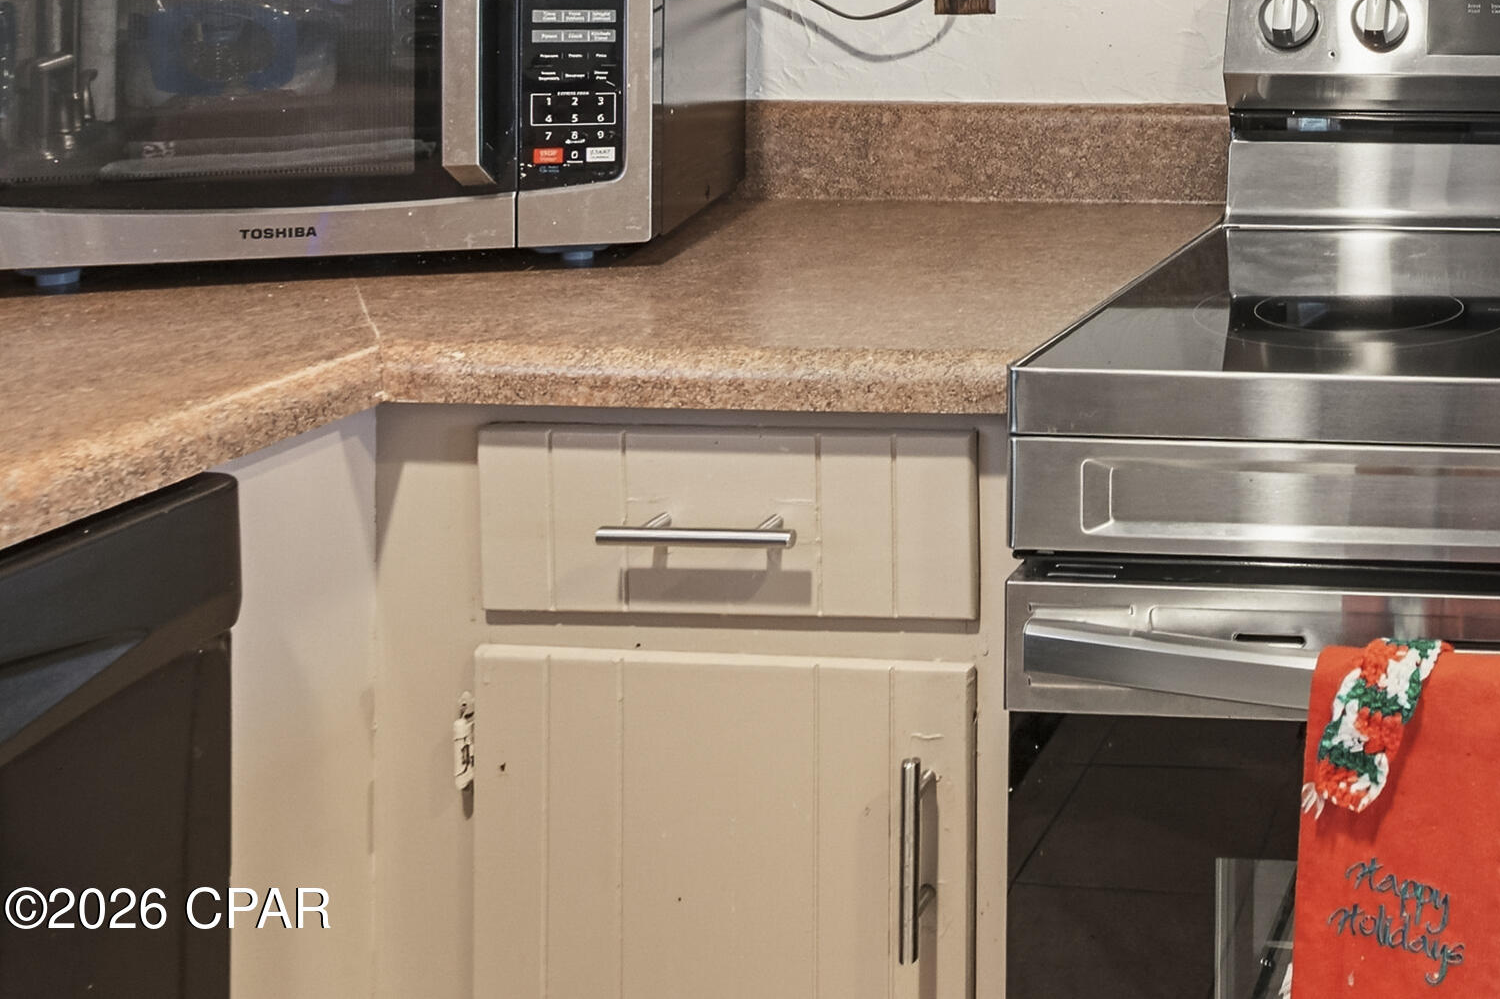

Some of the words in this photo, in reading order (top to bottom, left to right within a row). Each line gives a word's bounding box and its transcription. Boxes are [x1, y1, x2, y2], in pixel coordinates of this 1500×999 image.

[546, 97, 552, 106] 1
[571, 97, 579, 106] 2
[598, 97, 604, 105] 3
[545, 114, 553, 123] 4
[571, 114, 579, 123] 5
[596, 113, 605, 123] 6
[545, 131, 552, 141] 7
[571, 131, 579, 139] 8
[596, 131, 604, 139] 9
[571, 151, 579, 159] 0
[239, 227, 317, 239] TOSHIBA
[1344, 857, 1450, 935] Happy
[1327, 903, 1466, 987] Holidays
